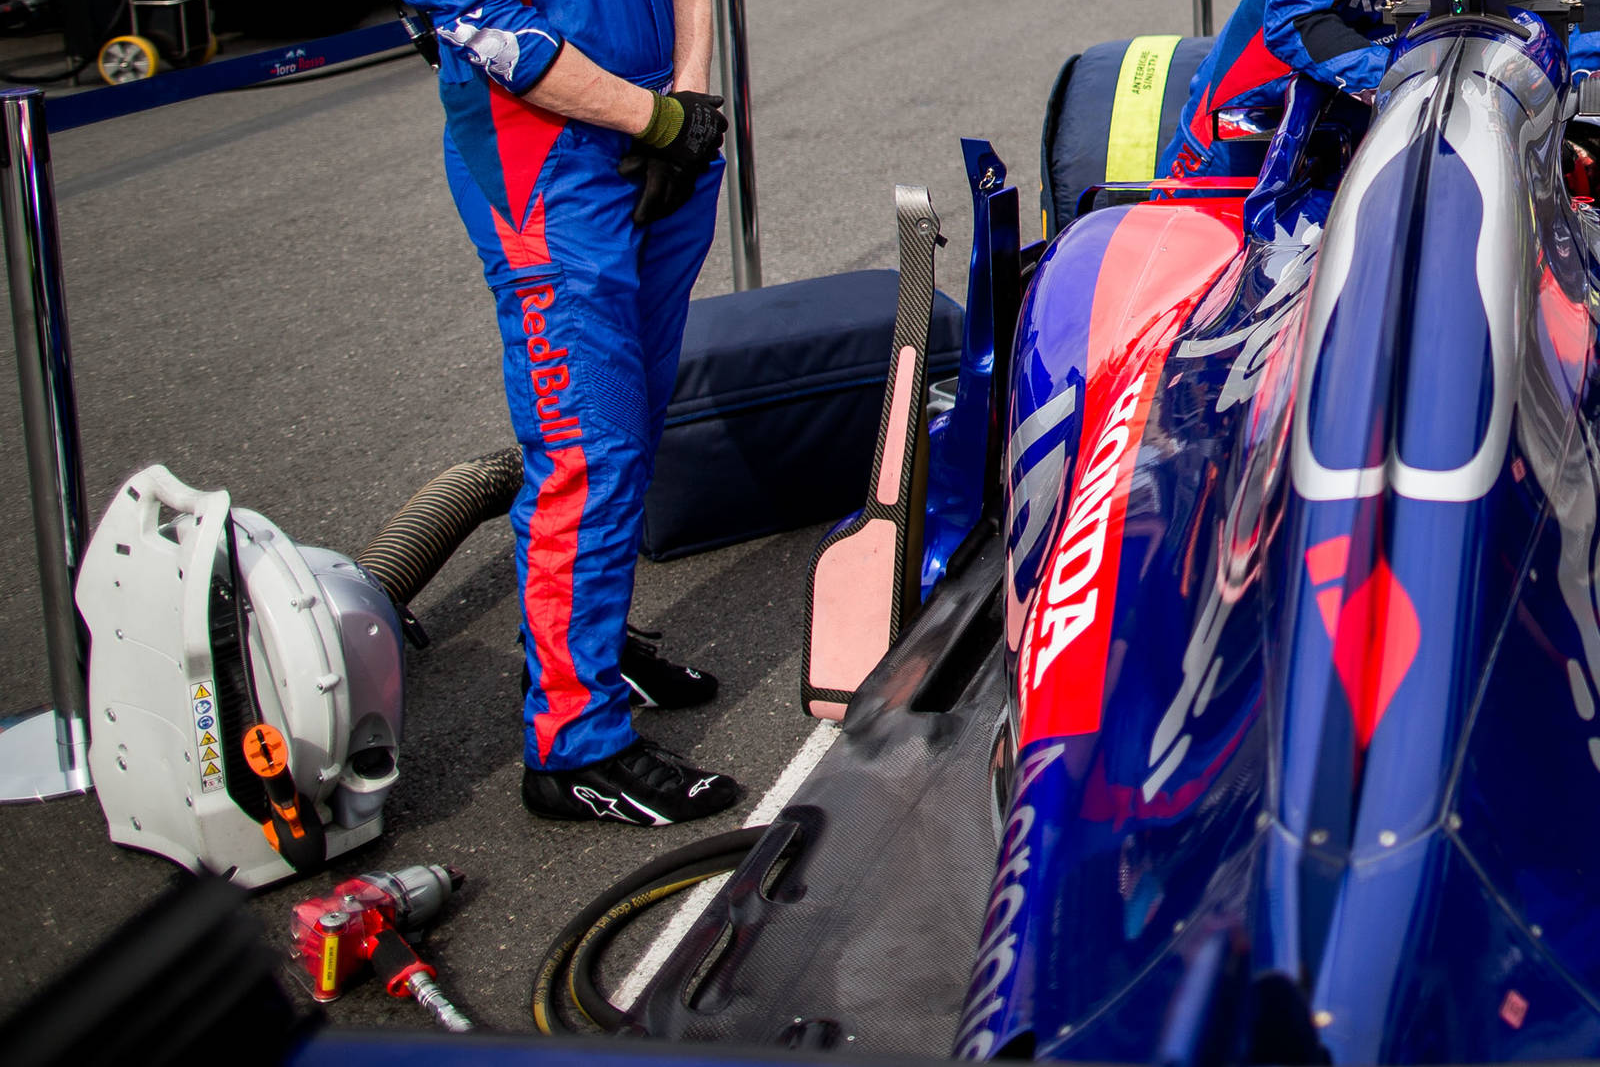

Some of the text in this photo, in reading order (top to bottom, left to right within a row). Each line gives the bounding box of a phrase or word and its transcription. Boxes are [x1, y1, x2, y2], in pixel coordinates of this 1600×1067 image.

[274, 63, 296, 76] Toro
[515, 284, 584, 445] Red Bull
[1034, 373, 1147, 690] HONDA
